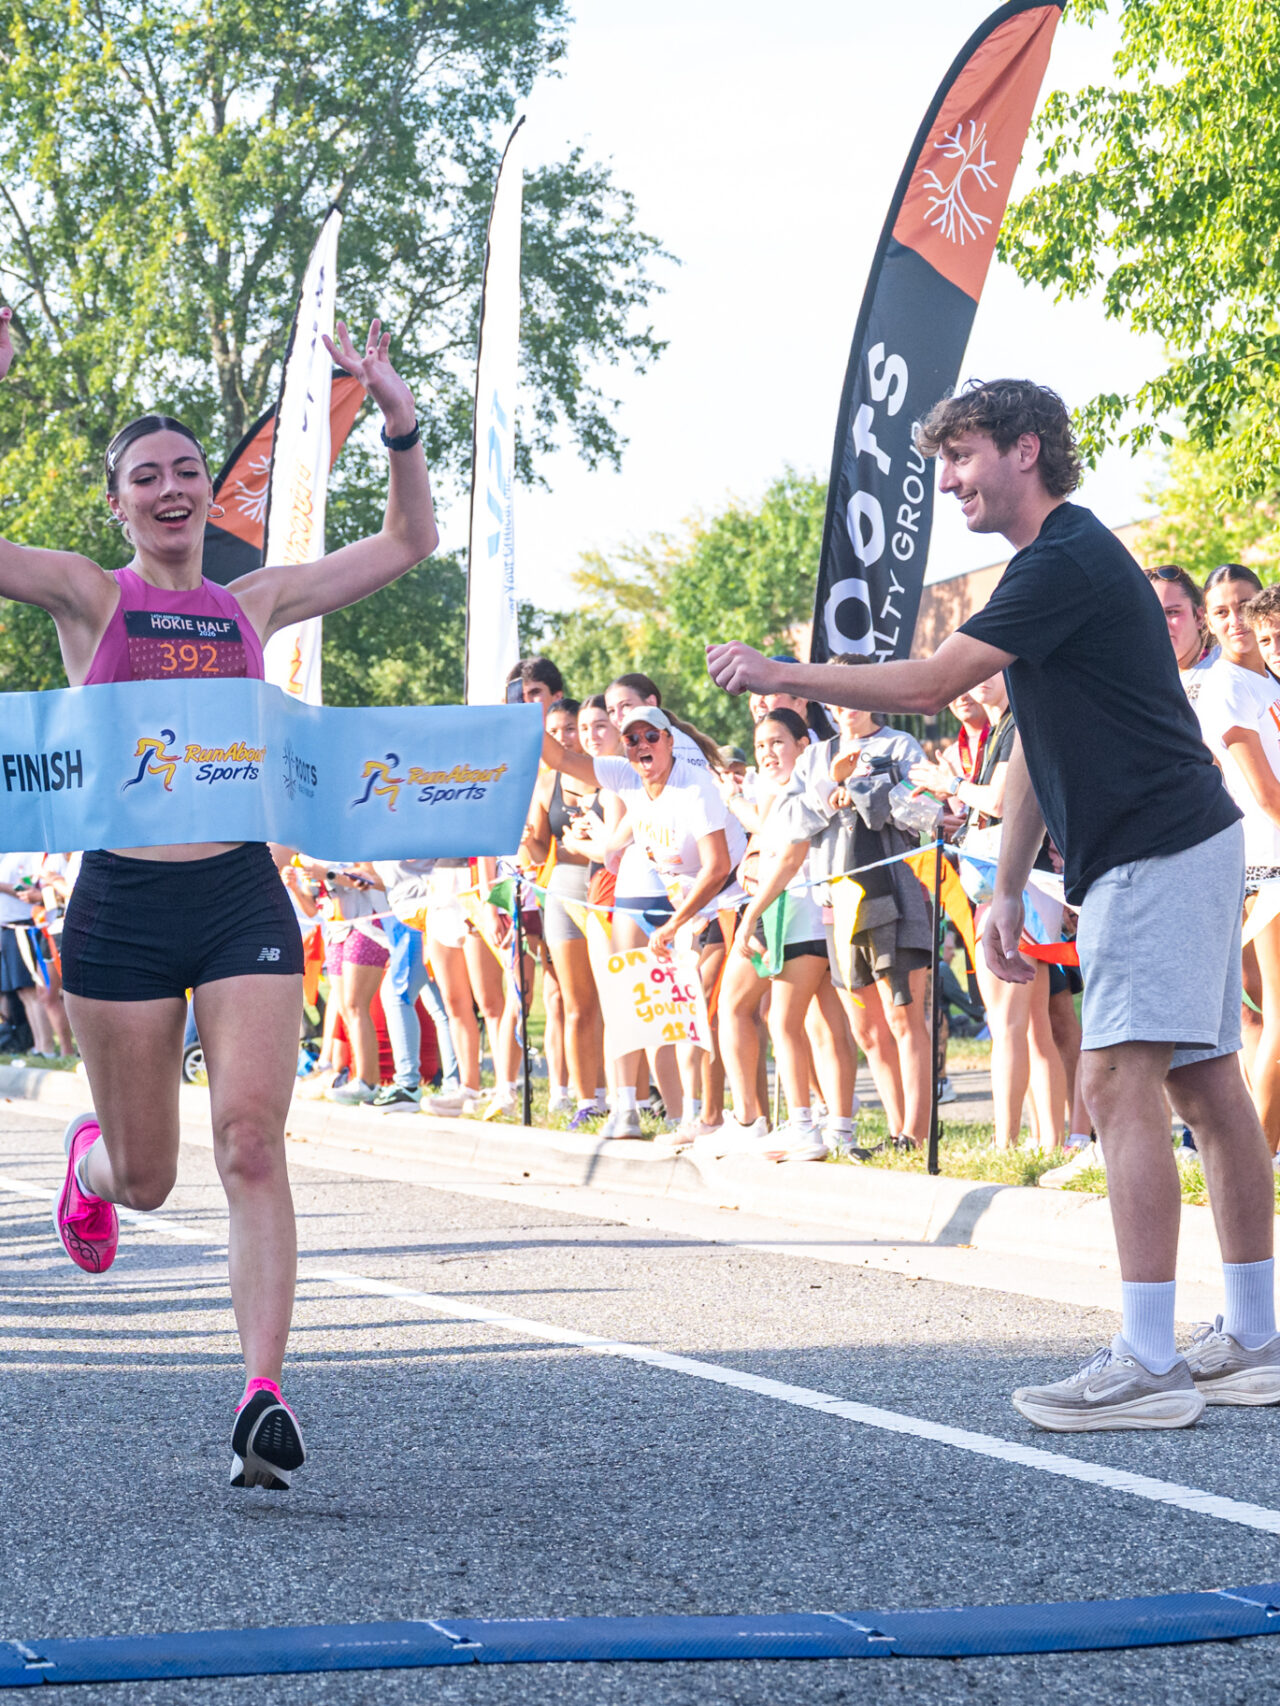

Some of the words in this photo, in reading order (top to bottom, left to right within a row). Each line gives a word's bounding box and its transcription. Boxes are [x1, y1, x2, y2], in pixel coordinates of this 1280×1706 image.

[824, 342, 908, 656] OOTS
[891, 421, 926, 561] GROUP
[151, 617, 194, 631] HOKIE
[196, 621, 231, 633] HALF
[160, 643, 220, 672] 392
[183, 741, 267, 763] RunAbout
[2, 749, 84, 793] FINISH
[195, 762, 259, 785] Sports
[407, 763, 508, 785] RunAbout
[417, 783, 487, 806] Sports
